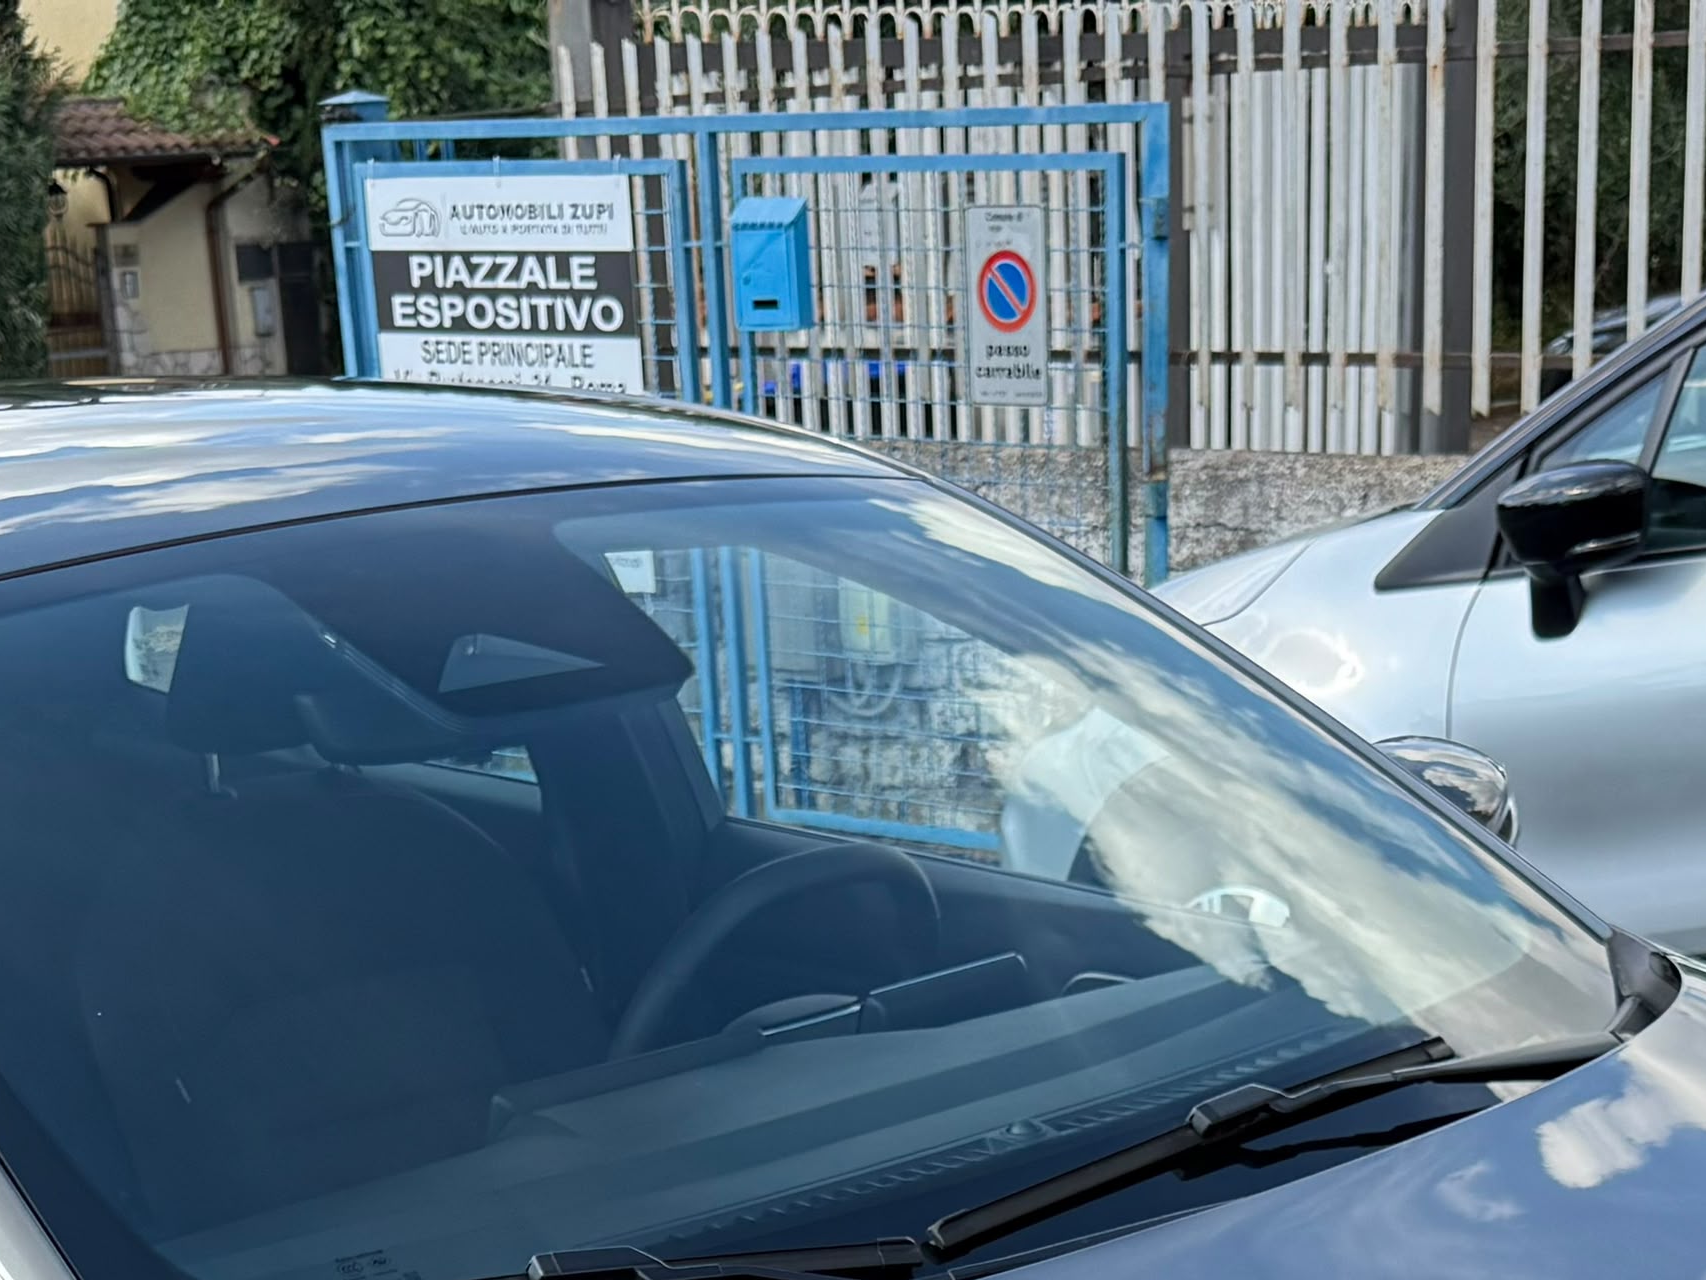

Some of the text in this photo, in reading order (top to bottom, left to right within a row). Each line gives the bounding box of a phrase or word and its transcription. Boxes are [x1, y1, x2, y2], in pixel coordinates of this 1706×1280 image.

[449, 203, 614, 221] AUTOMOBILI ZUPI
[408, 254, 598, 290] PIAZZALE
[390, 293, 625, 332] ESPOSITIVO
[421, 339, 595, 369] SEDE PRINCIPALE
[985, 345, 1031, 360] passo
[975, 363, 1042, 380] carrabile
